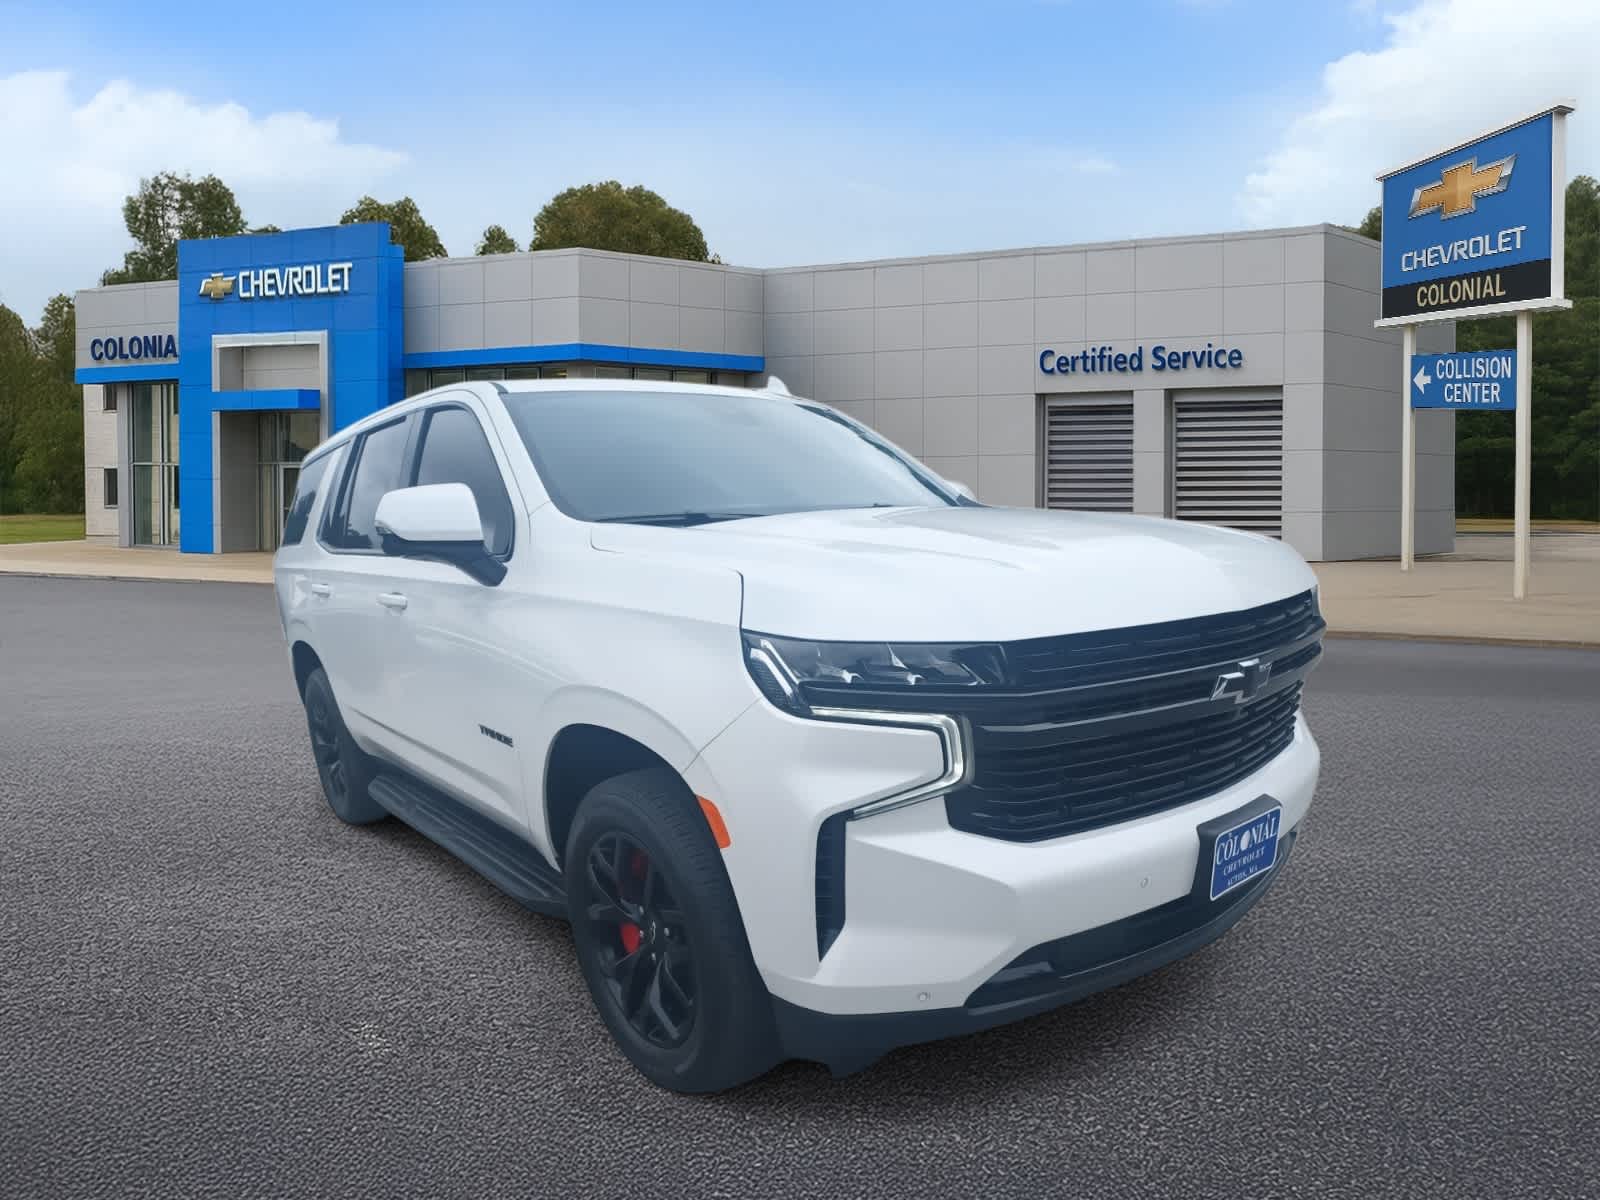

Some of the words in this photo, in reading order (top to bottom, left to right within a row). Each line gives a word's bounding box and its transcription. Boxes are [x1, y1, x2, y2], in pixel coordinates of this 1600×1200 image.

[1401, 225, 1527, 272] CHEVROLET
[238, 262, 352, 298] CHEVROLET
[1416, 273, 1506, 307] COLONIAL
[1039, 345, 1143, 374] Certified
[1151, 343, 1243, 371] Service
[1436, 357, 1511, 379] COLLISION
[1444, 382, 1501, 403] CENTER
